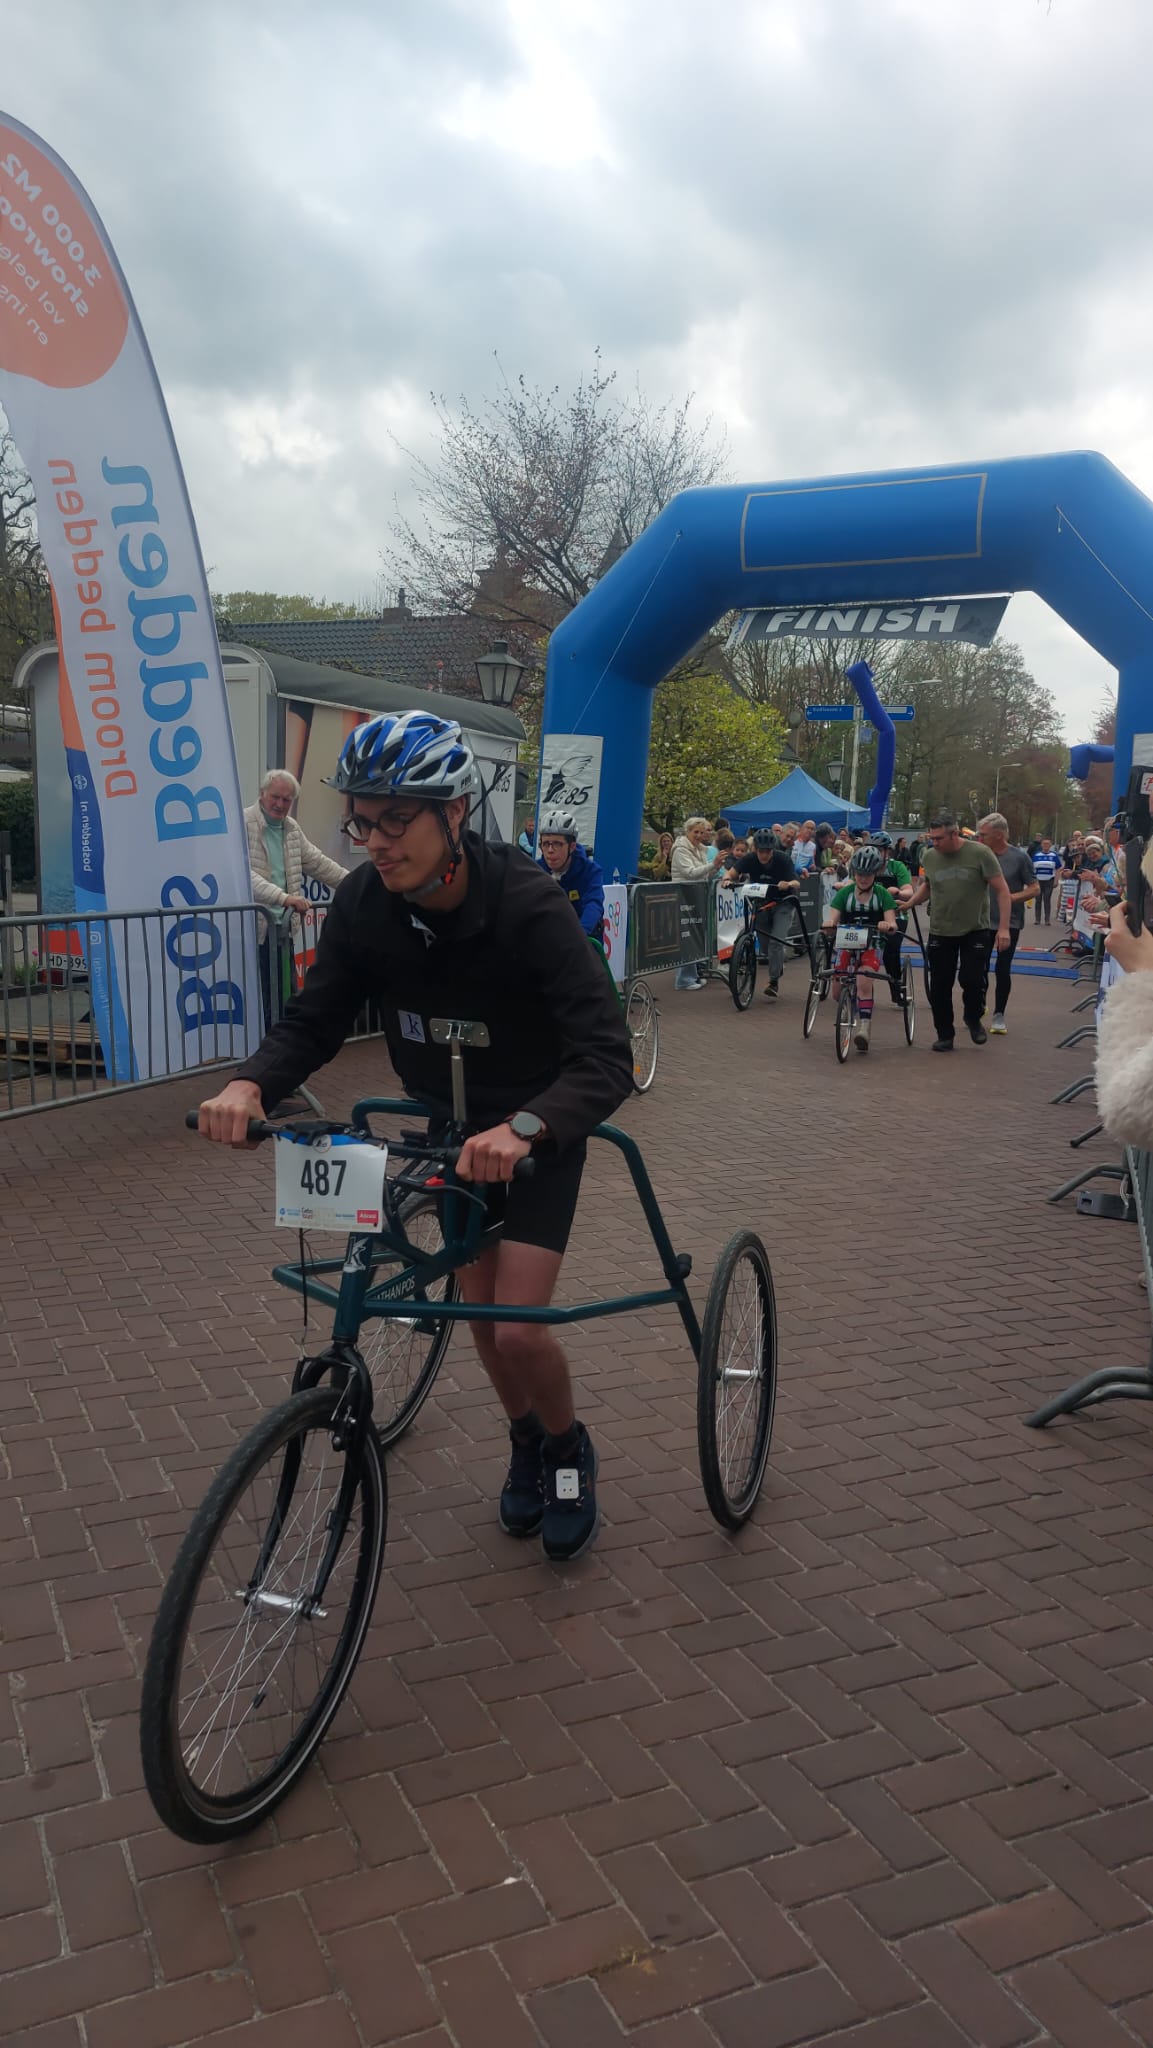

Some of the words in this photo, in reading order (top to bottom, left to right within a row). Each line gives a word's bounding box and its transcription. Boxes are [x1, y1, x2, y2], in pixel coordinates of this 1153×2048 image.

[766, 604, 961, 634] FINISH
[718, 894, 733, 921] Bos
[844, 931, 859, 943] 486
[300, 1159, 348, 1197] 487
[402, 1274, 416, 1295] POS
